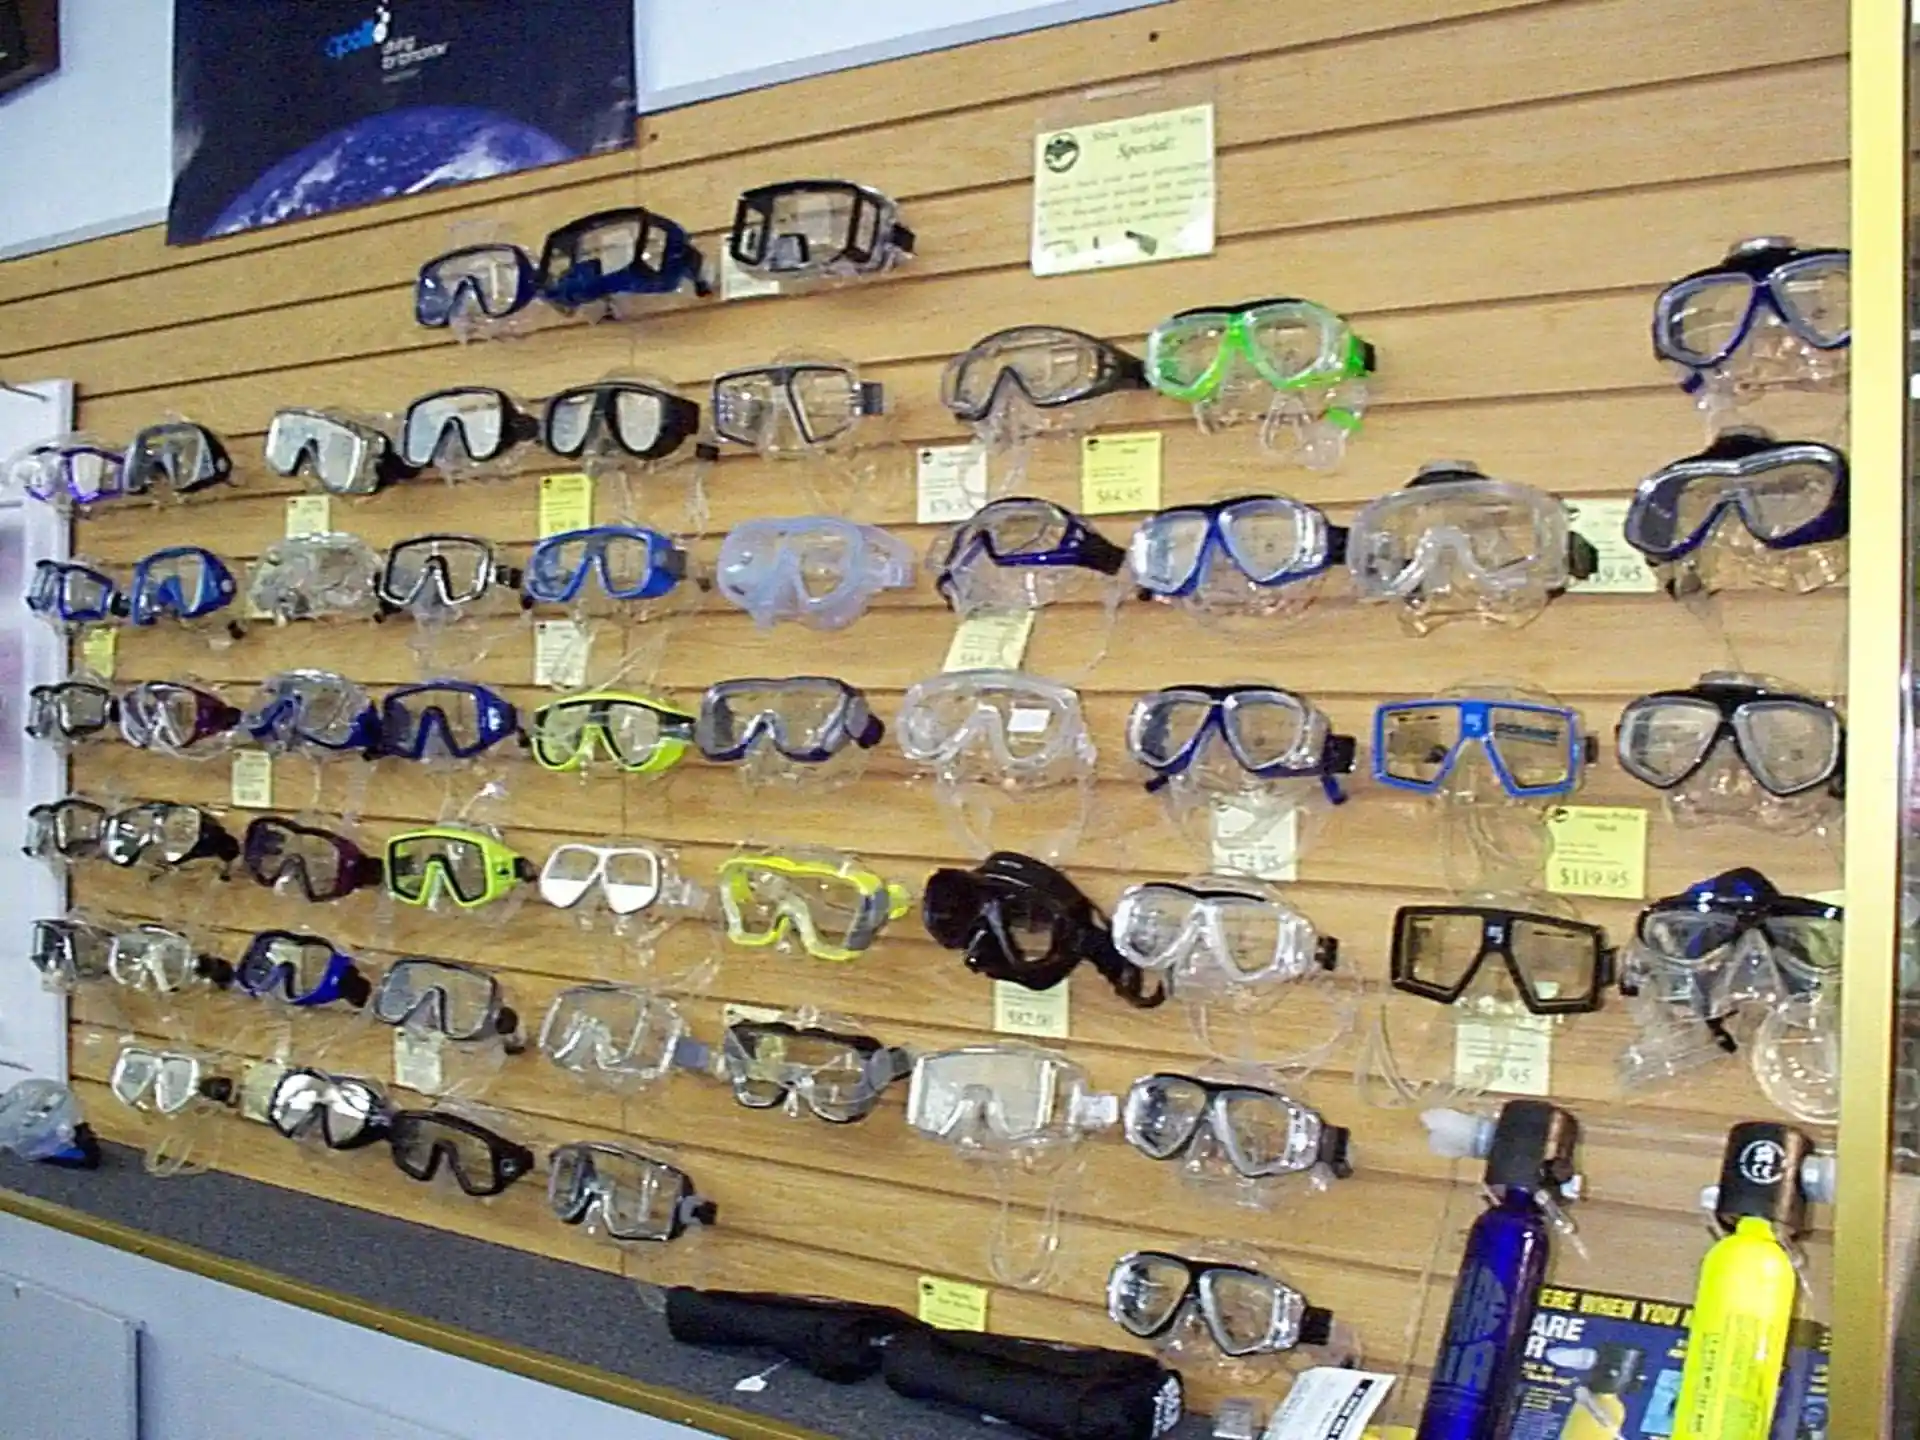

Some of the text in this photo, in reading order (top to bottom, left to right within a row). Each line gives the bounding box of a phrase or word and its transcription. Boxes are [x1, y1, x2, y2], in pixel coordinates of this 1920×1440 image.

[1560, 867, 1630, 889] $119.95
[1639, 1302, 1681, 1326] YOU
[1530, 1313, 1587, 1342] ARE
